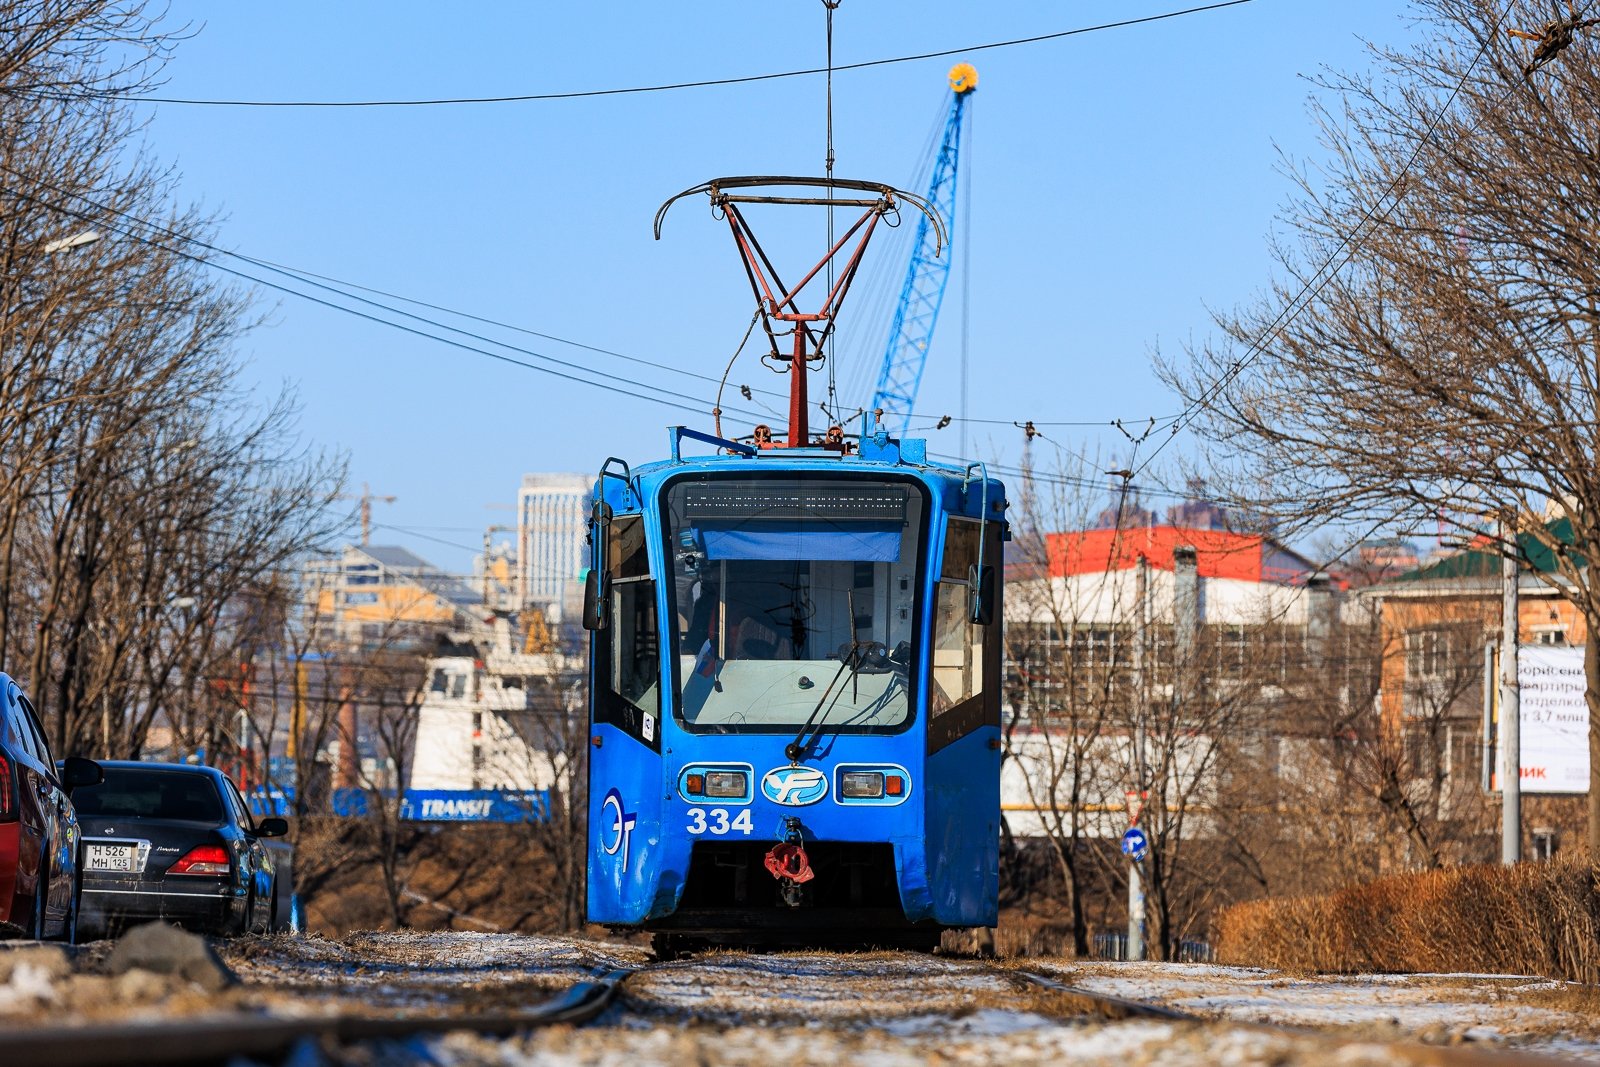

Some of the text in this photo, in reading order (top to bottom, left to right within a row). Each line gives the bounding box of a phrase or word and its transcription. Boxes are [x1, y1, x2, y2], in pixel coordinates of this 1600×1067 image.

[1533, 710, 1552, 723] 3,7
[421, 799, 494, 817] TRANSIT
[686, 808, 754, 834] 334
[105, 847, 125, 857] 526
[113, 859, 127, 867] 125
